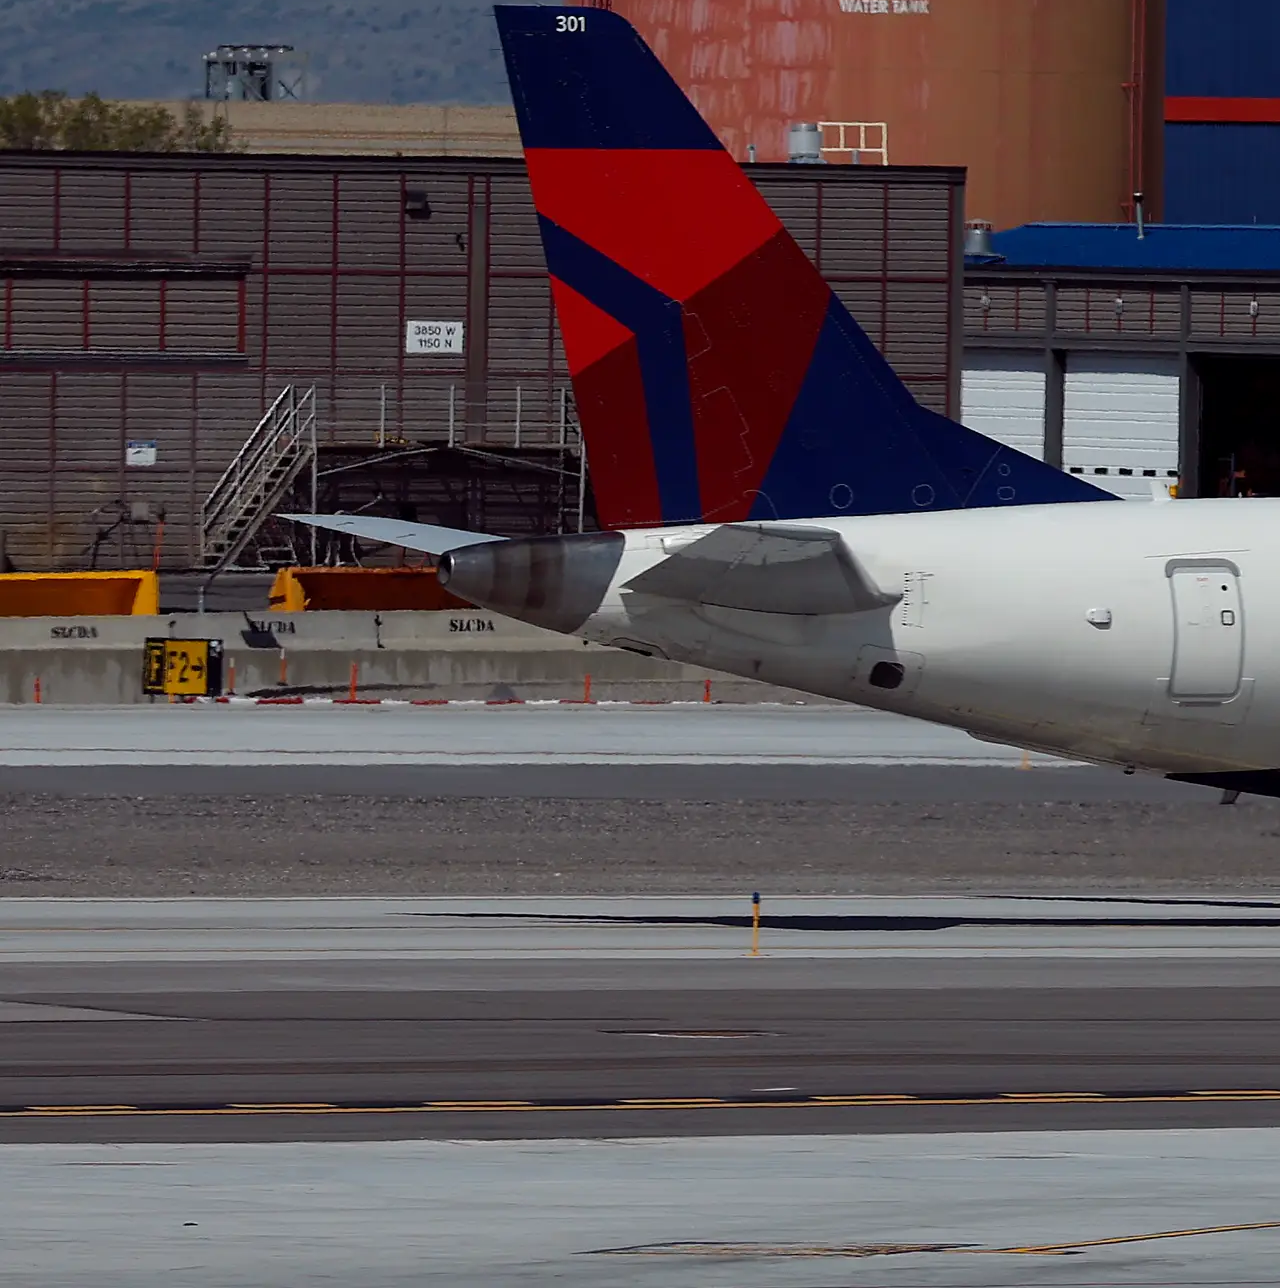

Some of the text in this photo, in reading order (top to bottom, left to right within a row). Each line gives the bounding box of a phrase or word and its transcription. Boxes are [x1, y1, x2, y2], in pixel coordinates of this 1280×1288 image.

[892, 0, 930, 14] TANK
[555, 15, 586, 33] 301
[414, 325, 457, 336] 3850 W
[418, 338, 453, 349] 1150 N
[449, 618, 496, 633] SLCDA
